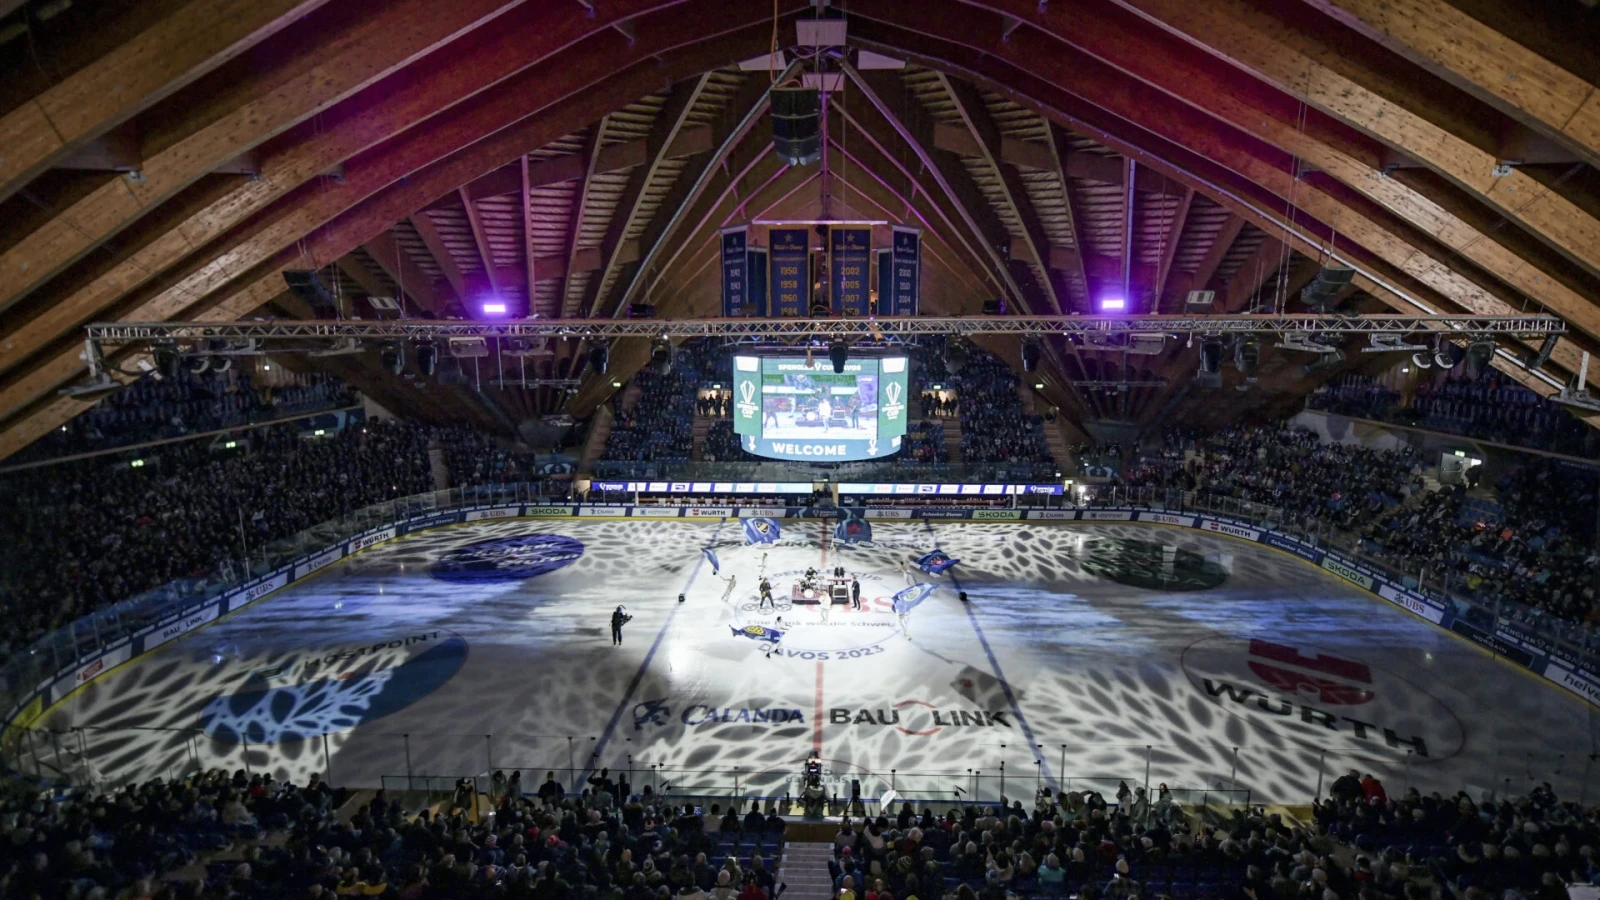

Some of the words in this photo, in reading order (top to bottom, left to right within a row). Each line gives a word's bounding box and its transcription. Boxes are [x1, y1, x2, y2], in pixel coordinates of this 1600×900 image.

[780, 266, 798, 275] 1950
[771, 442, 847, 456] WELCOME
[489, 509, 506, 517] UBS
[1162, 515, 1180, 524] UBS
[255, 581, 274, 596] UBS
[1404, 599, 1425, 614] UBS
[163, 626, 181, 638] BAU
[185, 614, 203, 628] LINK
[837, 644, 885, 660] 2023
[681, 704, 805, 725] CALANDA
[829, 708, 900, 725] BAU
[933, 710, 1011, 728] LINK
[1202, 678, 1428, 757] WÜRTH
